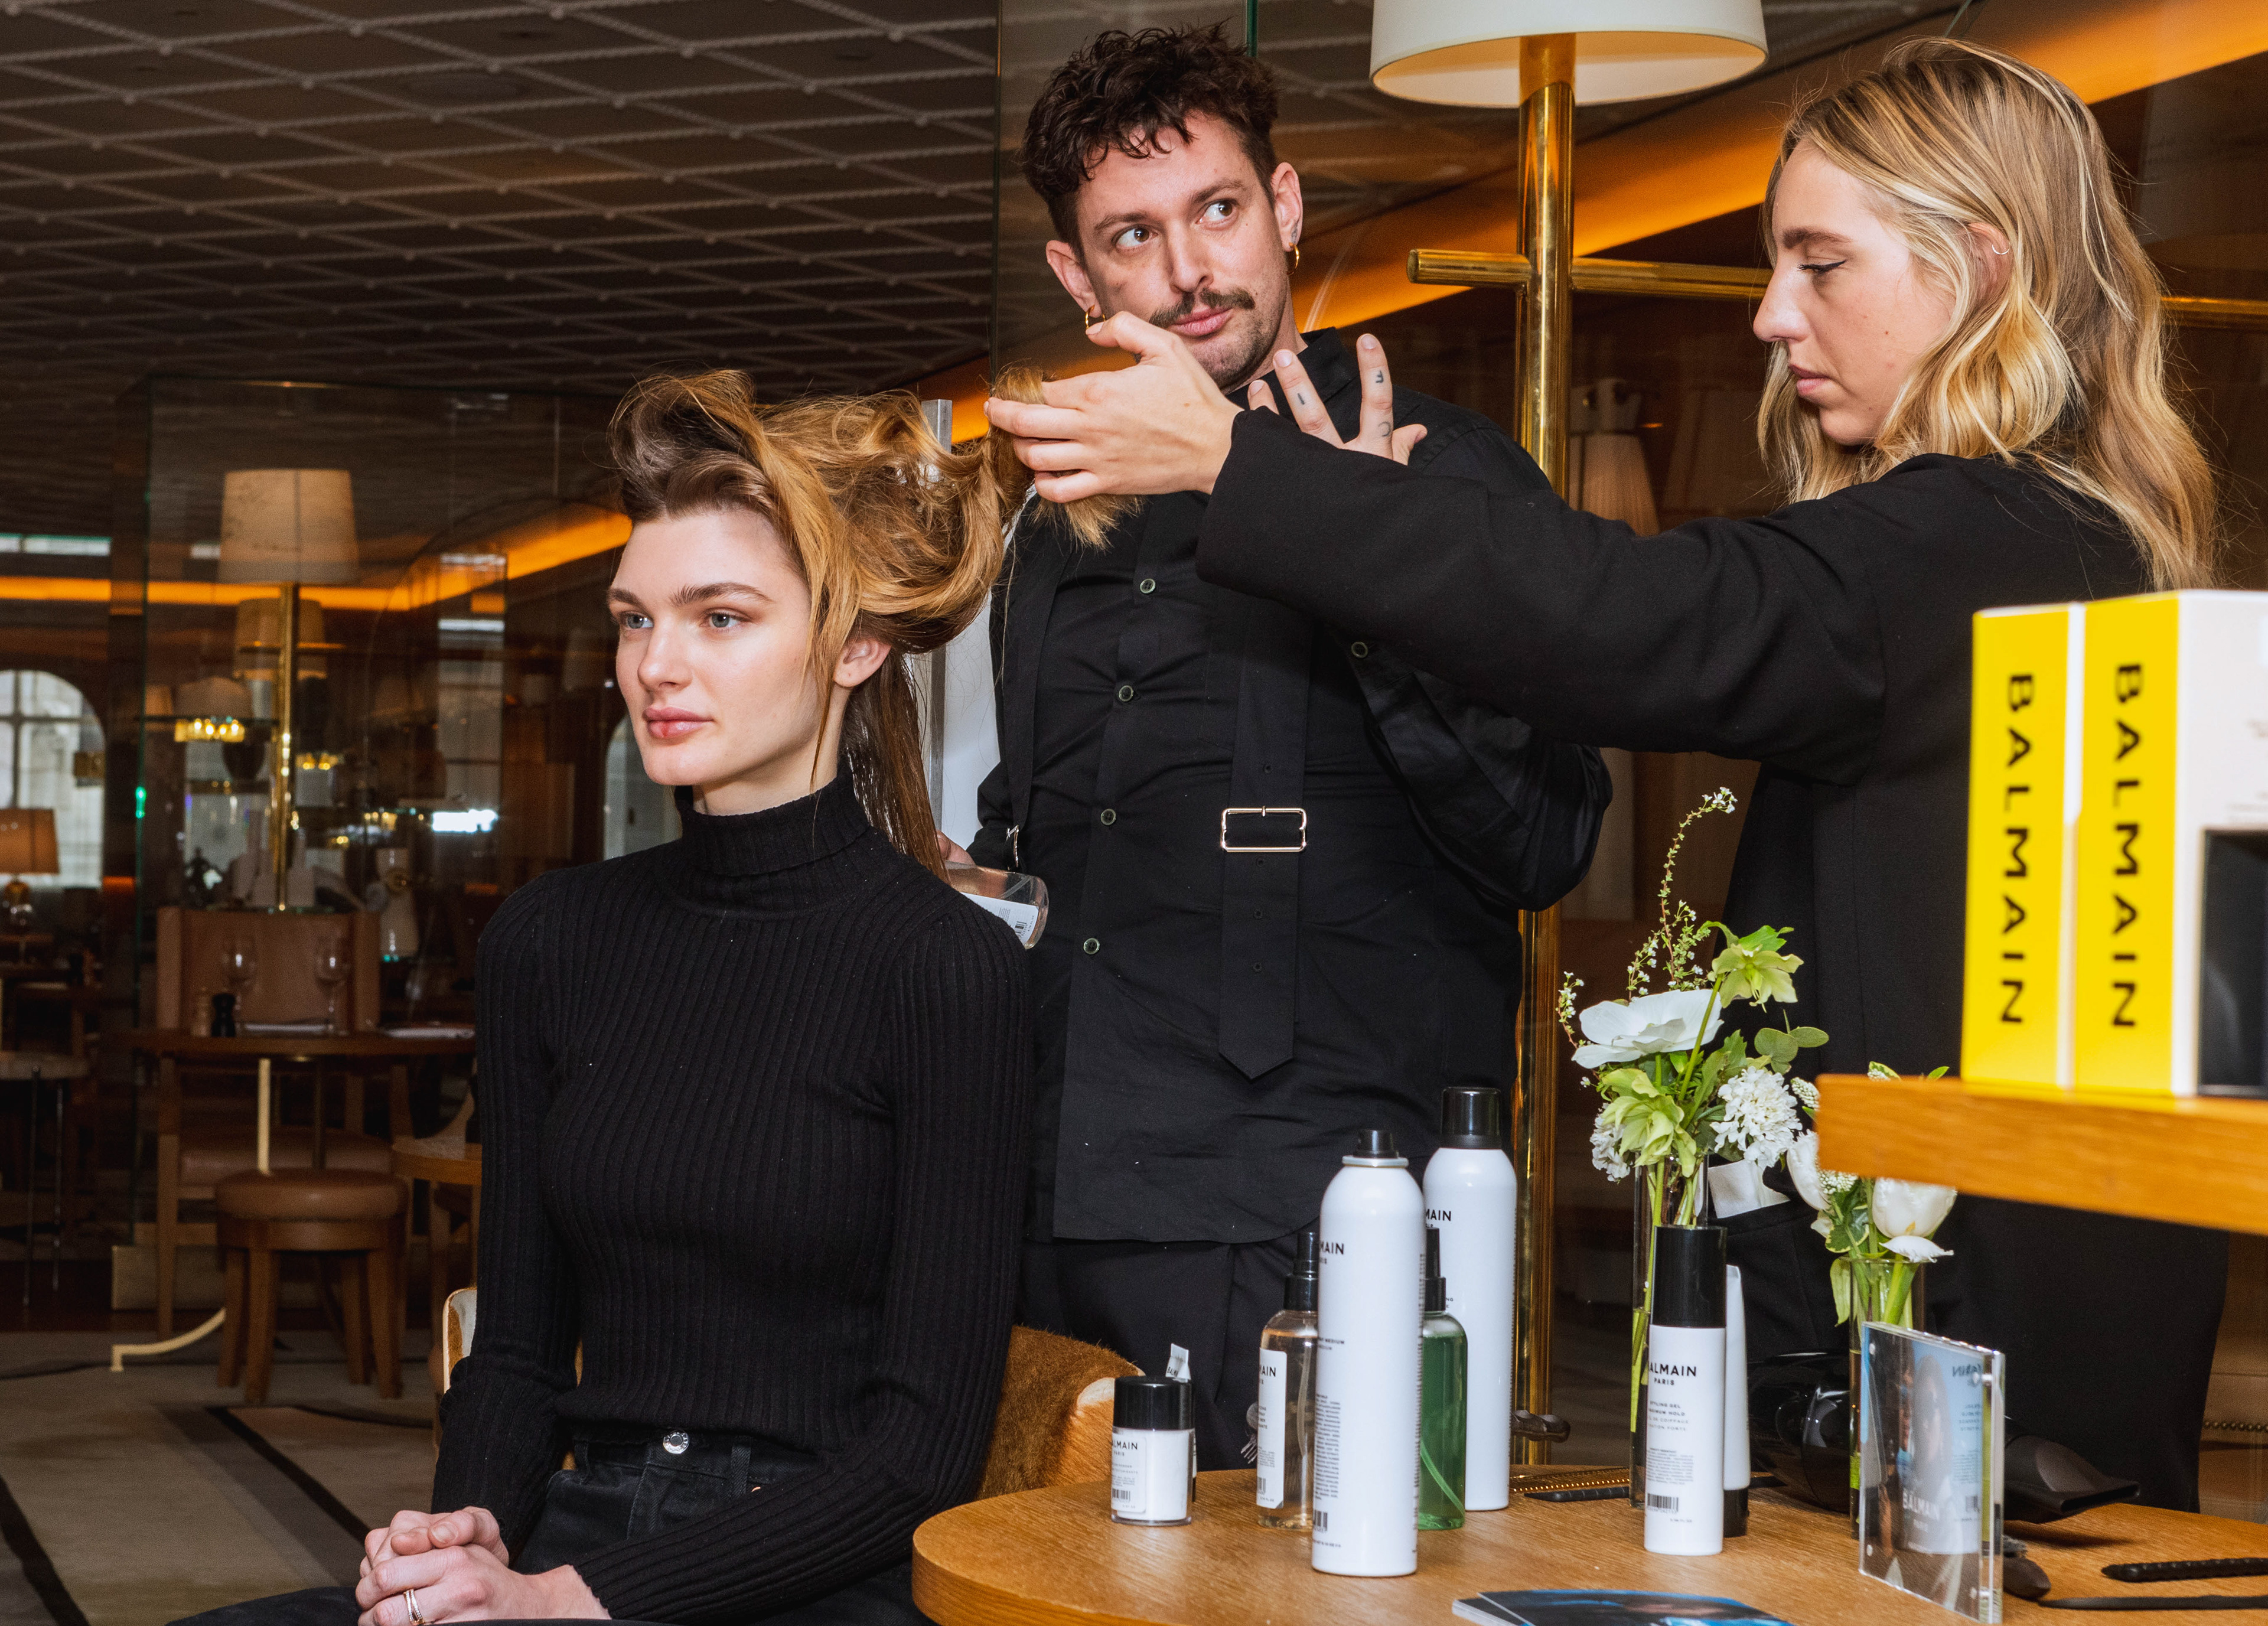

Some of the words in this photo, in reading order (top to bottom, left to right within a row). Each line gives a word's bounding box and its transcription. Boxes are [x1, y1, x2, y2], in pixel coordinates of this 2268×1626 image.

[2001, 674, 2034, 1022] BALMAIN
[2112, 665, 2142, 1027] BALMAIN
[1654, 1377, 1675, 1386] PARIS
